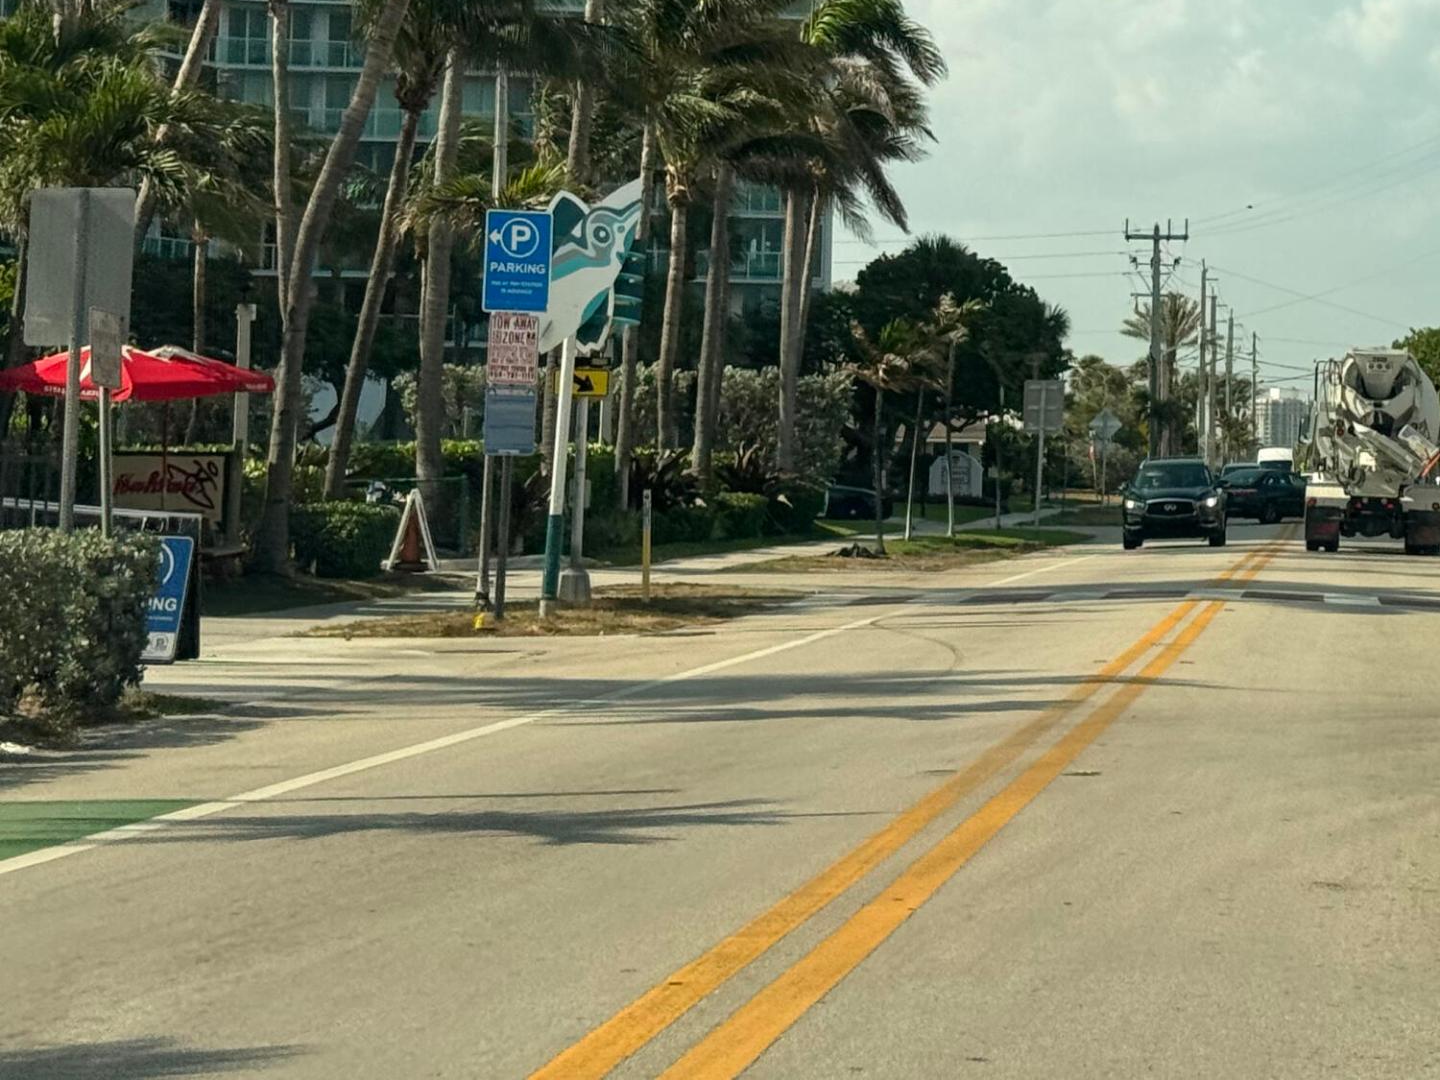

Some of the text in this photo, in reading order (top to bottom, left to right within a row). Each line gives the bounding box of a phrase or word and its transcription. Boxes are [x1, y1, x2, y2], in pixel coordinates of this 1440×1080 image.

[511, 224, 532, 251] P
[489, 261, 546, 275] PARKING
[492, 316, 536, 330] TOW AWAY
[502, 331, 525, 345] ZONE
